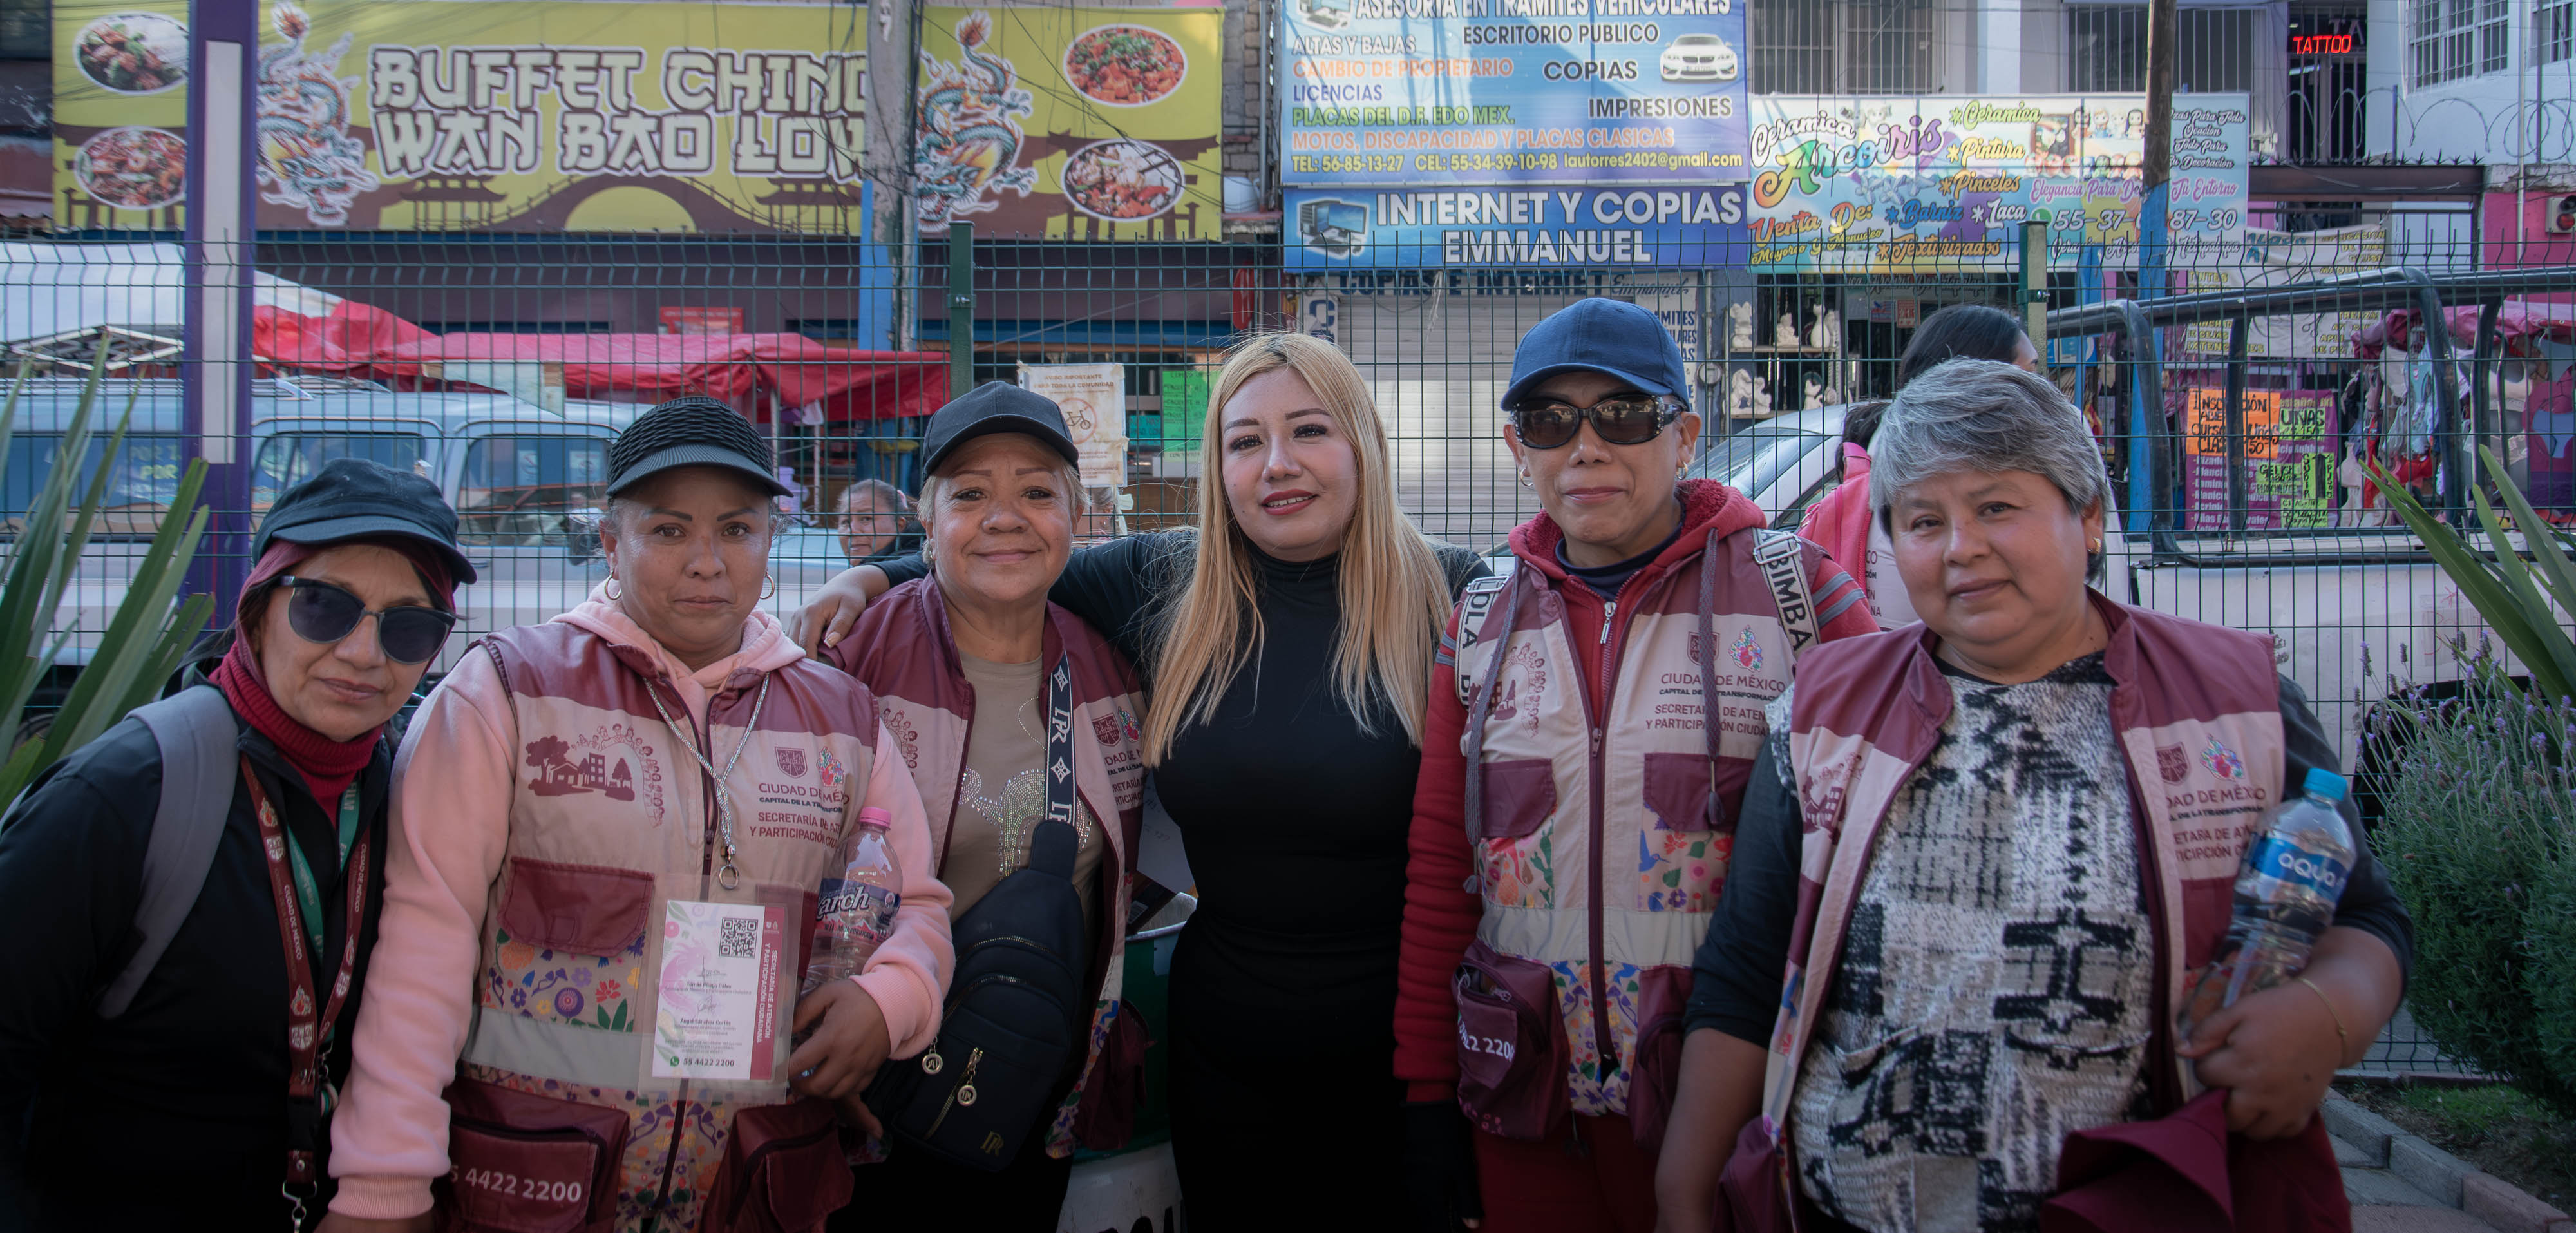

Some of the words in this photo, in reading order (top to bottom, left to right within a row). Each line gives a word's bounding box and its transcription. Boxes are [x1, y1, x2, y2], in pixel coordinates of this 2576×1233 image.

[1463, 0, 1488, 17] EN
[1596, 0, 1731, 16] VEHICULARES
[1463, 24, 1573, 44] ESCRITORIO
[1578, 23, 1660, 43] PUBLICO
[2292, 35, 2352, 54] TATTOO
[1292, 36, 1342, 56] ALTAS
[1345, 36, 1358, 55] Y
[1361, 35, 1416, 55] BAJAS
[1293, 60, 1366, 78] CAMBIO
[1372, 60, 1393, 78] DE
[1398, 57, 1513, 78] PROPIETARIO
[1544, 60, 1638, 81] COPIAS
[372, 46, 644, 112] BUFFET
[1293, 84, 1383, 102] LICENCIAS
[1292, 108, 1360, 127] PLACAS
[1363, 107, 1395, 126] DEL
[1397, 106, 1430, 126] D.F.
[1432, 106, 1469, 125] EDO
[1473, 105, 1515, 125] MEX.
[1588, 97, 1732, 119] IMPRESIONES
[1963, 100, 2043, 130] Ceramica
[374, 110, 540, 175] WAN
[560, 112, 713, 174] BAO
[1293, 131, 1361, 154] MOTOS,
[1365, 130, 1498, 151] DISCAPACIDAD
[1501, 130, 1512, 149] Y
[1516, 129, 1584, 149] PLACAS
[1587, 128, 1674, 148] CLASICAS
[1750, 109, 1857, 169] Ceramica
[1291, 155, 1319, 173] TEL:
[1322, 155, 1405, 173] 56-85-13-27
[1415, 154, 1446, 172] CEL:
[1450, 153, 1558, 171] 55-34-39-10-98
[1753, 115, 1944, 209] Arcoiris
[1960, 136, 2026, 169] Pintura
[1952, 169, 2021, 200] Pinceles
[2030, 178, 2085, 204] Elegancia
[2192, 178, 2239, 202] Entorno
[1376, 191, 1550, 225] INTERNET
[1557, 191, 1583, 224] Y
[1592, 190, 1742, 224] COPIAS
[1899, 198, 1965, 230] Barniz
[1747, 210, 1822, 248] Venta
[1829, 202, 1873, 234] De:
[1441, 229, 1652, 263] EMMANUEL
[1751, 243, 1806, 265] Mayoreo
[1765, 550, 1813, 652] BIMBA
[1461, 592, 1491, 650] OLA
[1659, 688, 1691, 696] CAPITAL
[1660, 673, 1701, 685] CIUDA
[1736, 674, 1786, 694] MÉXICO
[1723, 706, 1737, 718] DE
[1645, 720, 1653, 731] Y
[1104, 751, 1127, 766] DAD
[758, 783, 807, 797] CIUDAD
[759, 796, 791, 805] CAPITAL
[2197, 789, 2219, 804] DE
[758, 811, 819, 827] SECRETARÍA
[749, 826, 757, 837] Y
[769, 949, 778, 992] SECRETARÍA
[683, 1057, 693, 1066] 55
[694, 1058, 714, 1067] 4422
[715, 1058, 735, 1067] 2200
[464, 1170, 518, 1196] 4422
[522, 1178, 582, 1203] 2200
